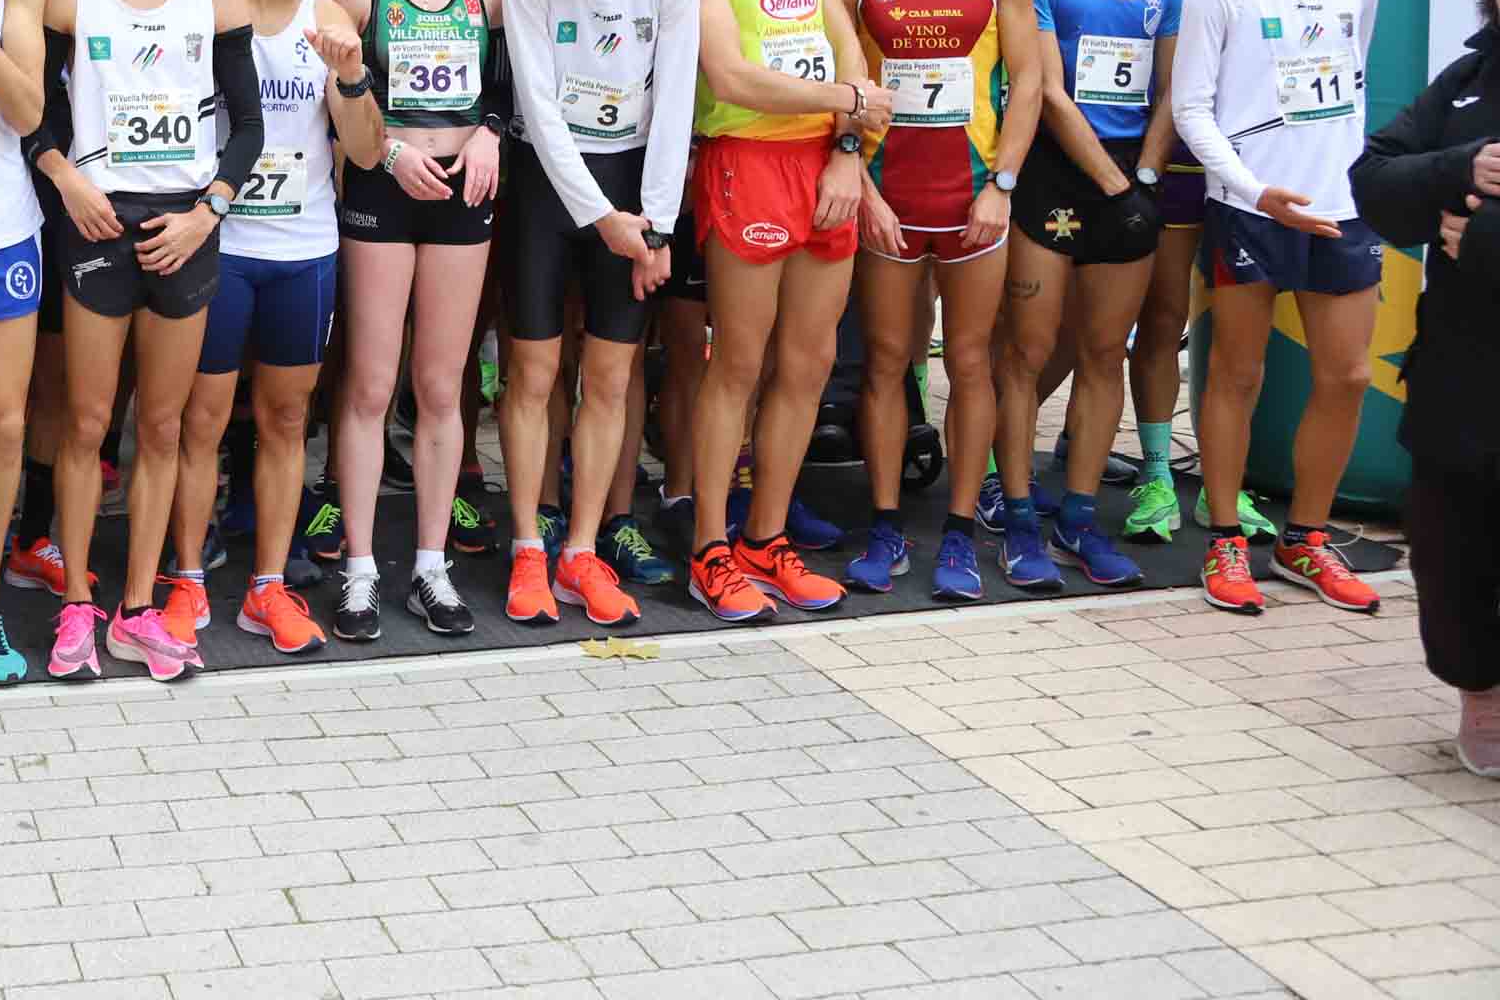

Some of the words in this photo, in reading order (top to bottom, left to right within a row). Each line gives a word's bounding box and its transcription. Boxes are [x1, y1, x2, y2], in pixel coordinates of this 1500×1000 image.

[388, 28, 463, 40] VILLARREAL
[892, 38, 913, 49] DE
[915, 37, 961, 49] TORO
[905, 24, 947, 36] VINO
[409, 65, 468, 93] 361
[795, 56, 827, 83] 25
[1114, 62, 1133, 88] 5
[922, 83, 944, 109] 7
[1310, 74, 1341, 104] 11
[596, 104, 619, 128] 3
[127, 115, 192, 146] 340
[243, 173, 288, 201] 27
[747, 227, 786, 242] Serrano
